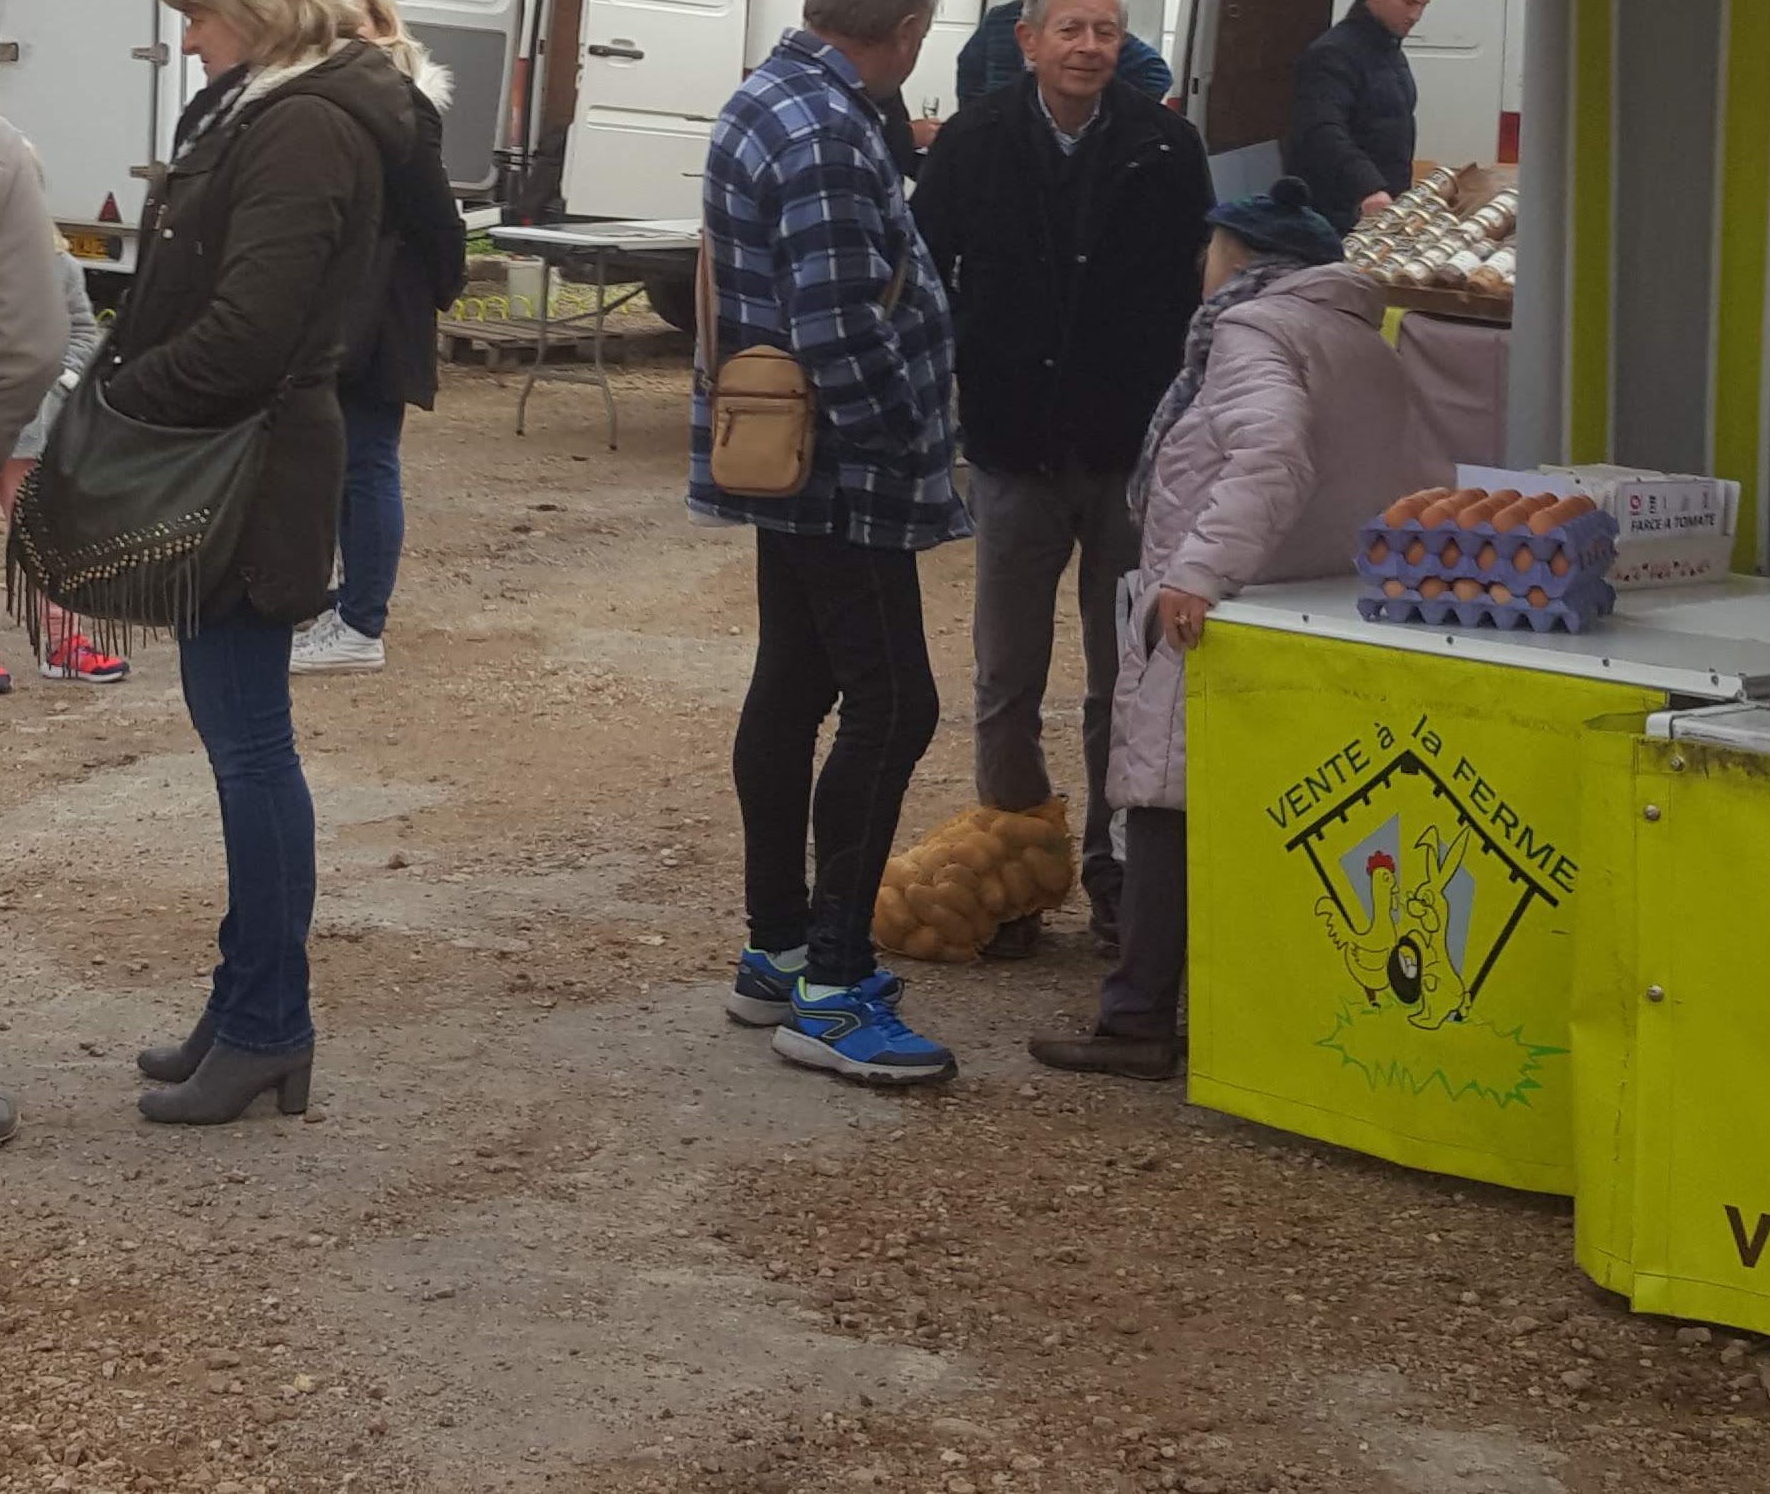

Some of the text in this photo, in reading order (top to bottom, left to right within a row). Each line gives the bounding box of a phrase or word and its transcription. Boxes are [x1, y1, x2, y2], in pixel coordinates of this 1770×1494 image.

[1266, 713, 1580, 894] VENTE à la FERME
